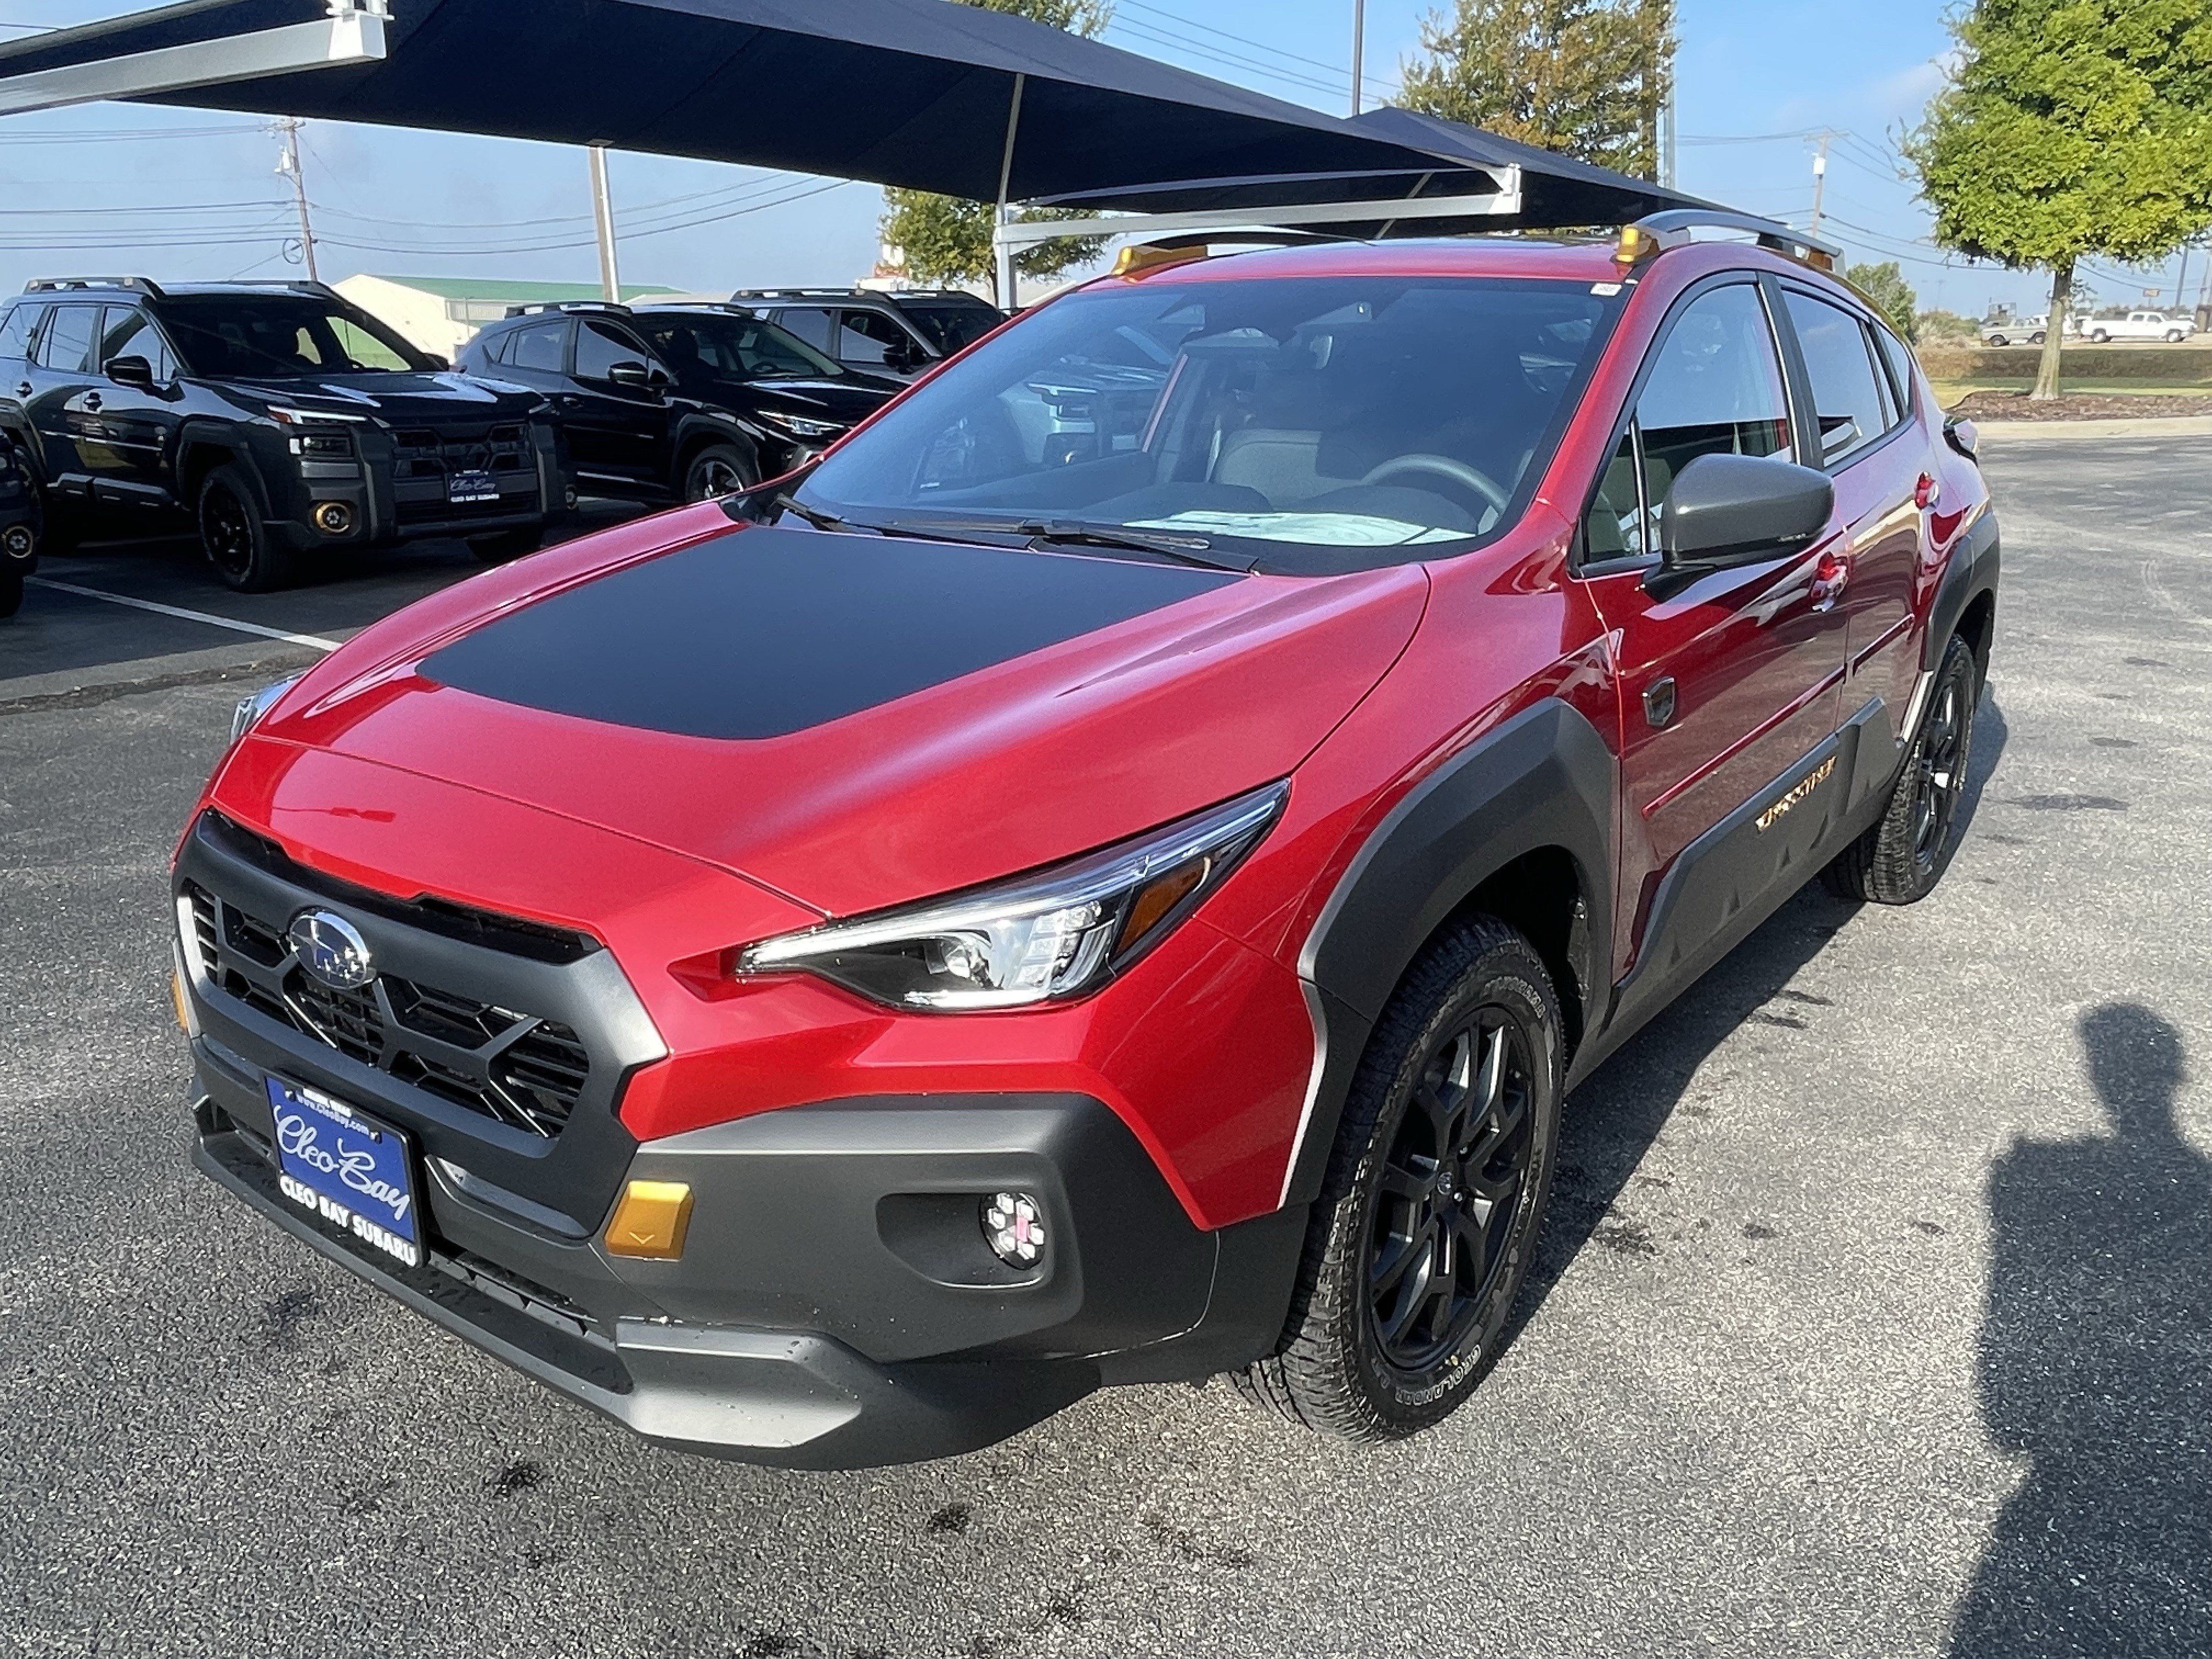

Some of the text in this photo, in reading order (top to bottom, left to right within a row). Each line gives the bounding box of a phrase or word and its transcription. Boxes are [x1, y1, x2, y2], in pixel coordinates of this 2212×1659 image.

[274, 1105, 410, 1221] Cleo Bay
[280, 1175, 417, 1267] CLEO BAY SUBARU
